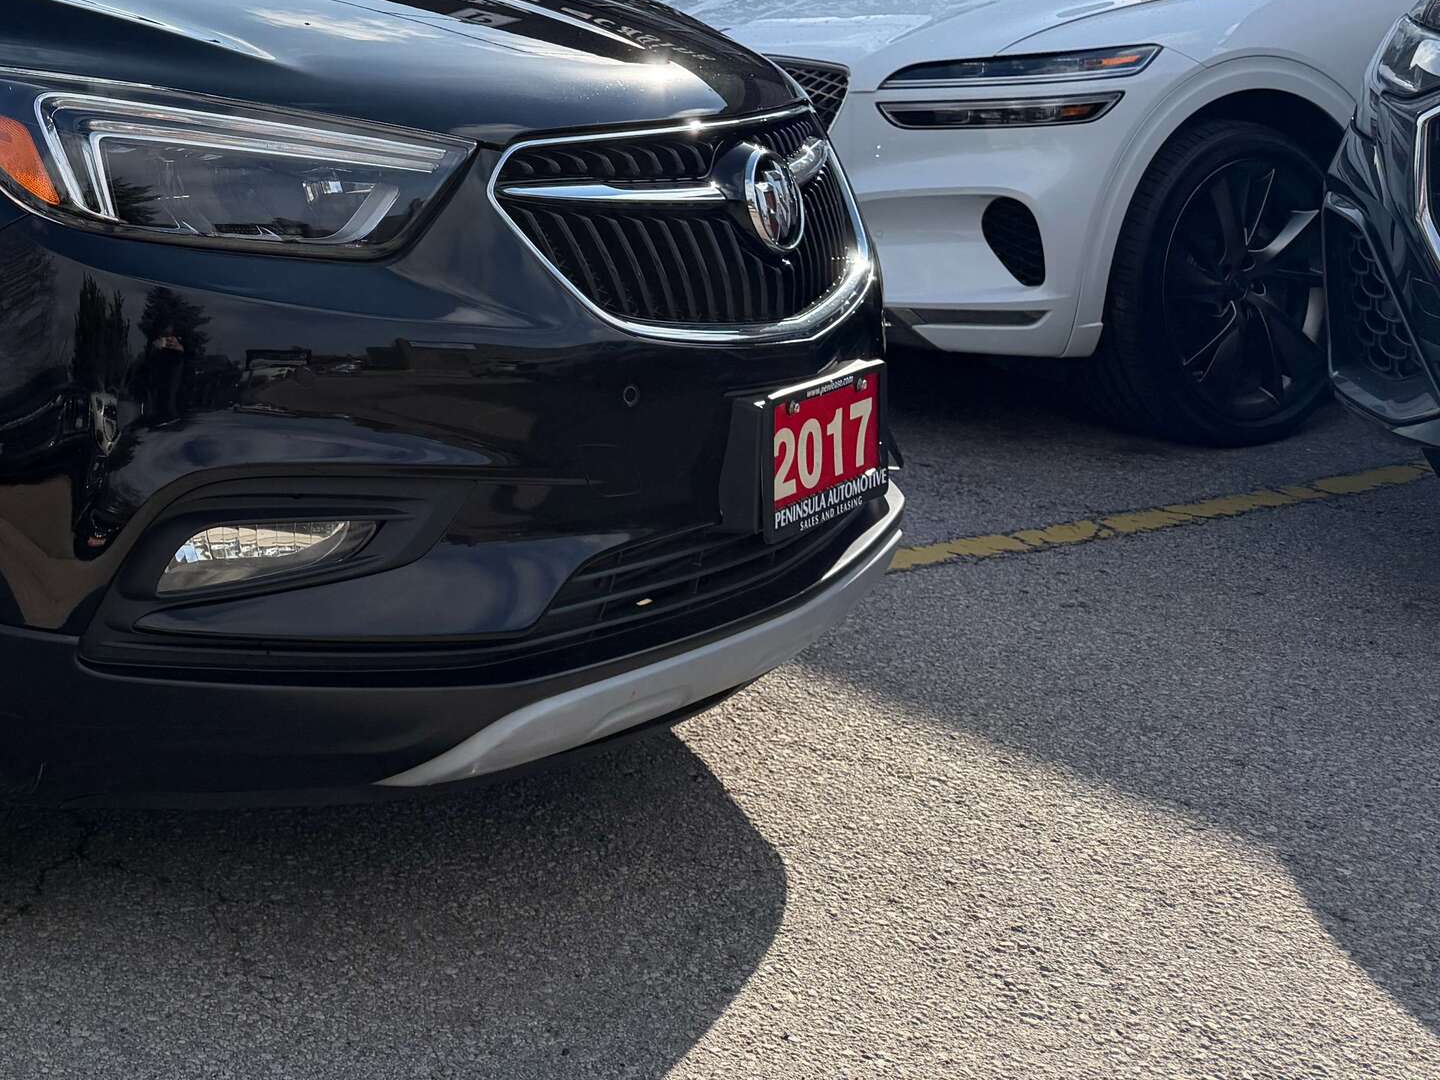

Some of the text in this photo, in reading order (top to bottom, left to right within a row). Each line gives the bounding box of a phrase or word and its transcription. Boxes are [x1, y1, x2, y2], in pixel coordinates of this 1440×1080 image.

[773, 397, 873, 501] 2017
[774, 467, 888, 530] PENINSULA AUTOMOTIVE
[799, 495, 864, 531] SALES AND LEASING
